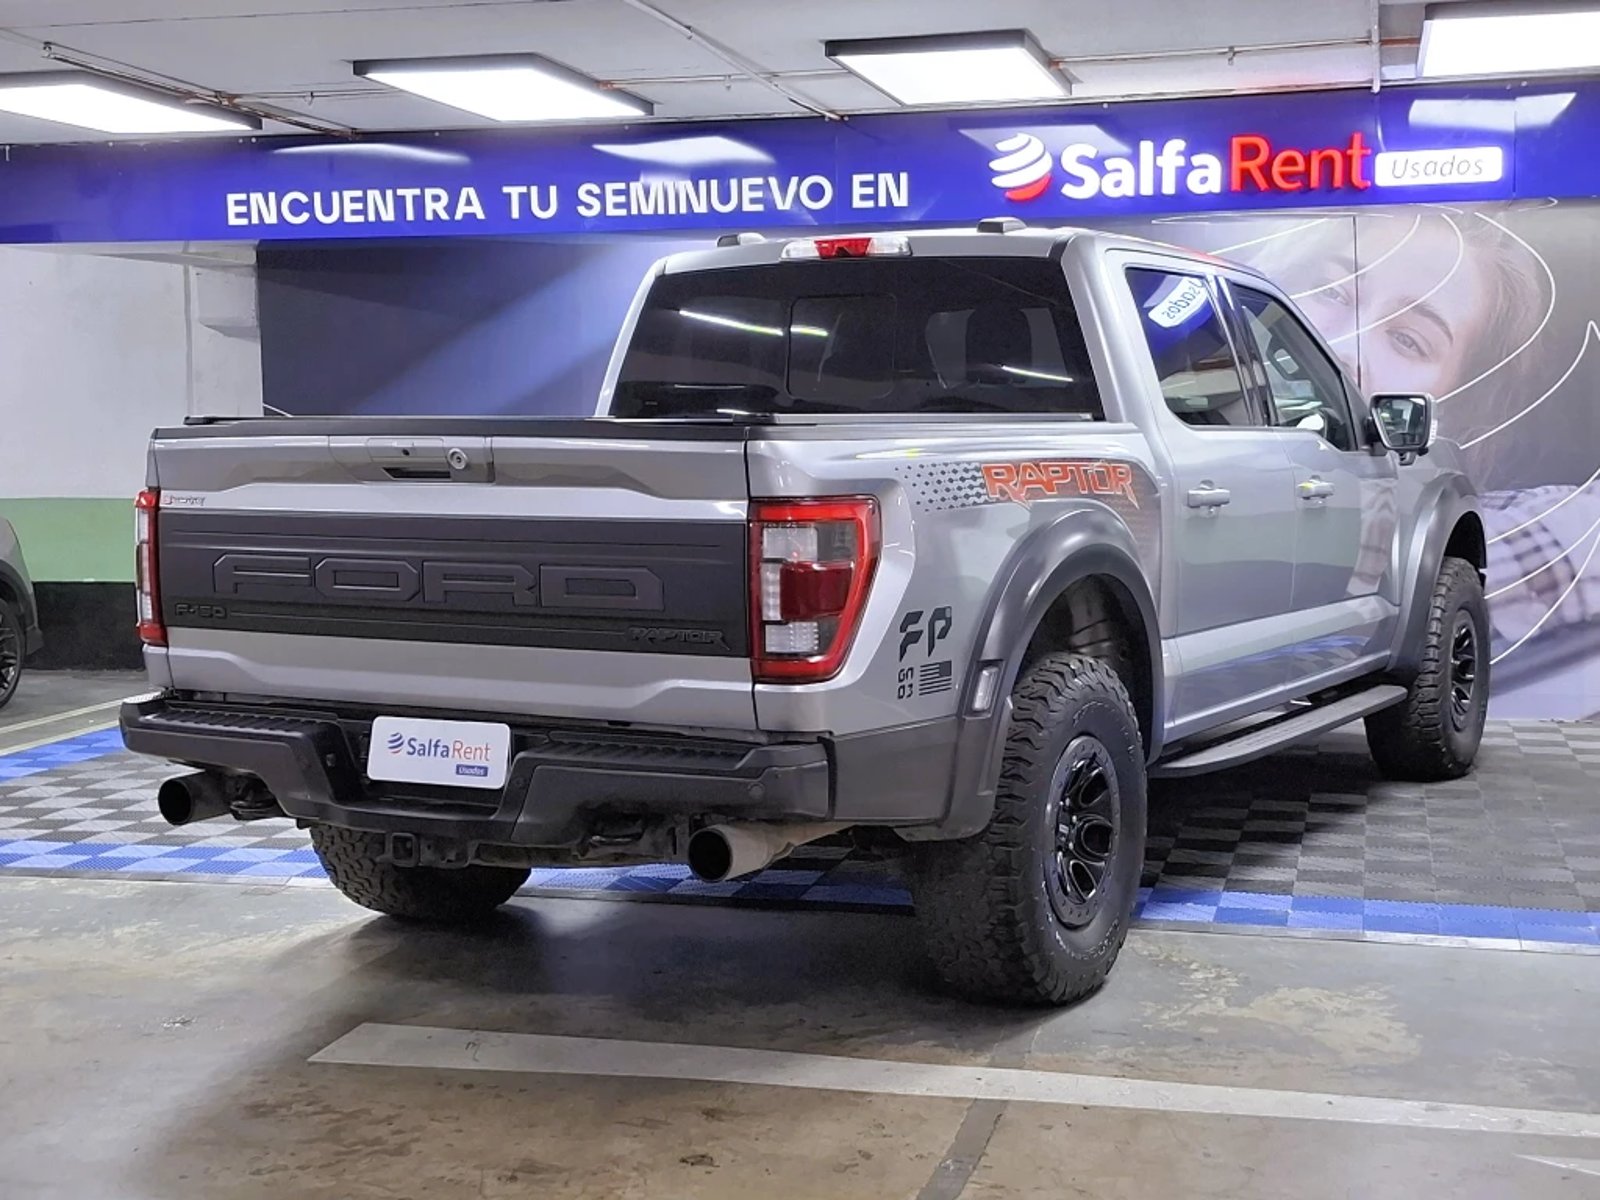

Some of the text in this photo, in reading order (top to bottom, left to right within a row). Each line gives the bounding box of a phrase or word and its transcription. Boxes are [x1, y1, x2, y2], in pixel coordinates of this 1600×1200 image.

[1060, 132, 1372, 199] SalfaRent
[1390, 155, 1484, 180] Usados
[226, 172, 909, 226] ENCUENTRA TU SEMINUEVO EN
[981, 462, 1139, 510] RAPTOR
[212, 553, 664, 612] FORD
[627, 626, 731, 650] RAPTOR
[406, 737, 491, 761] SalfaRent
